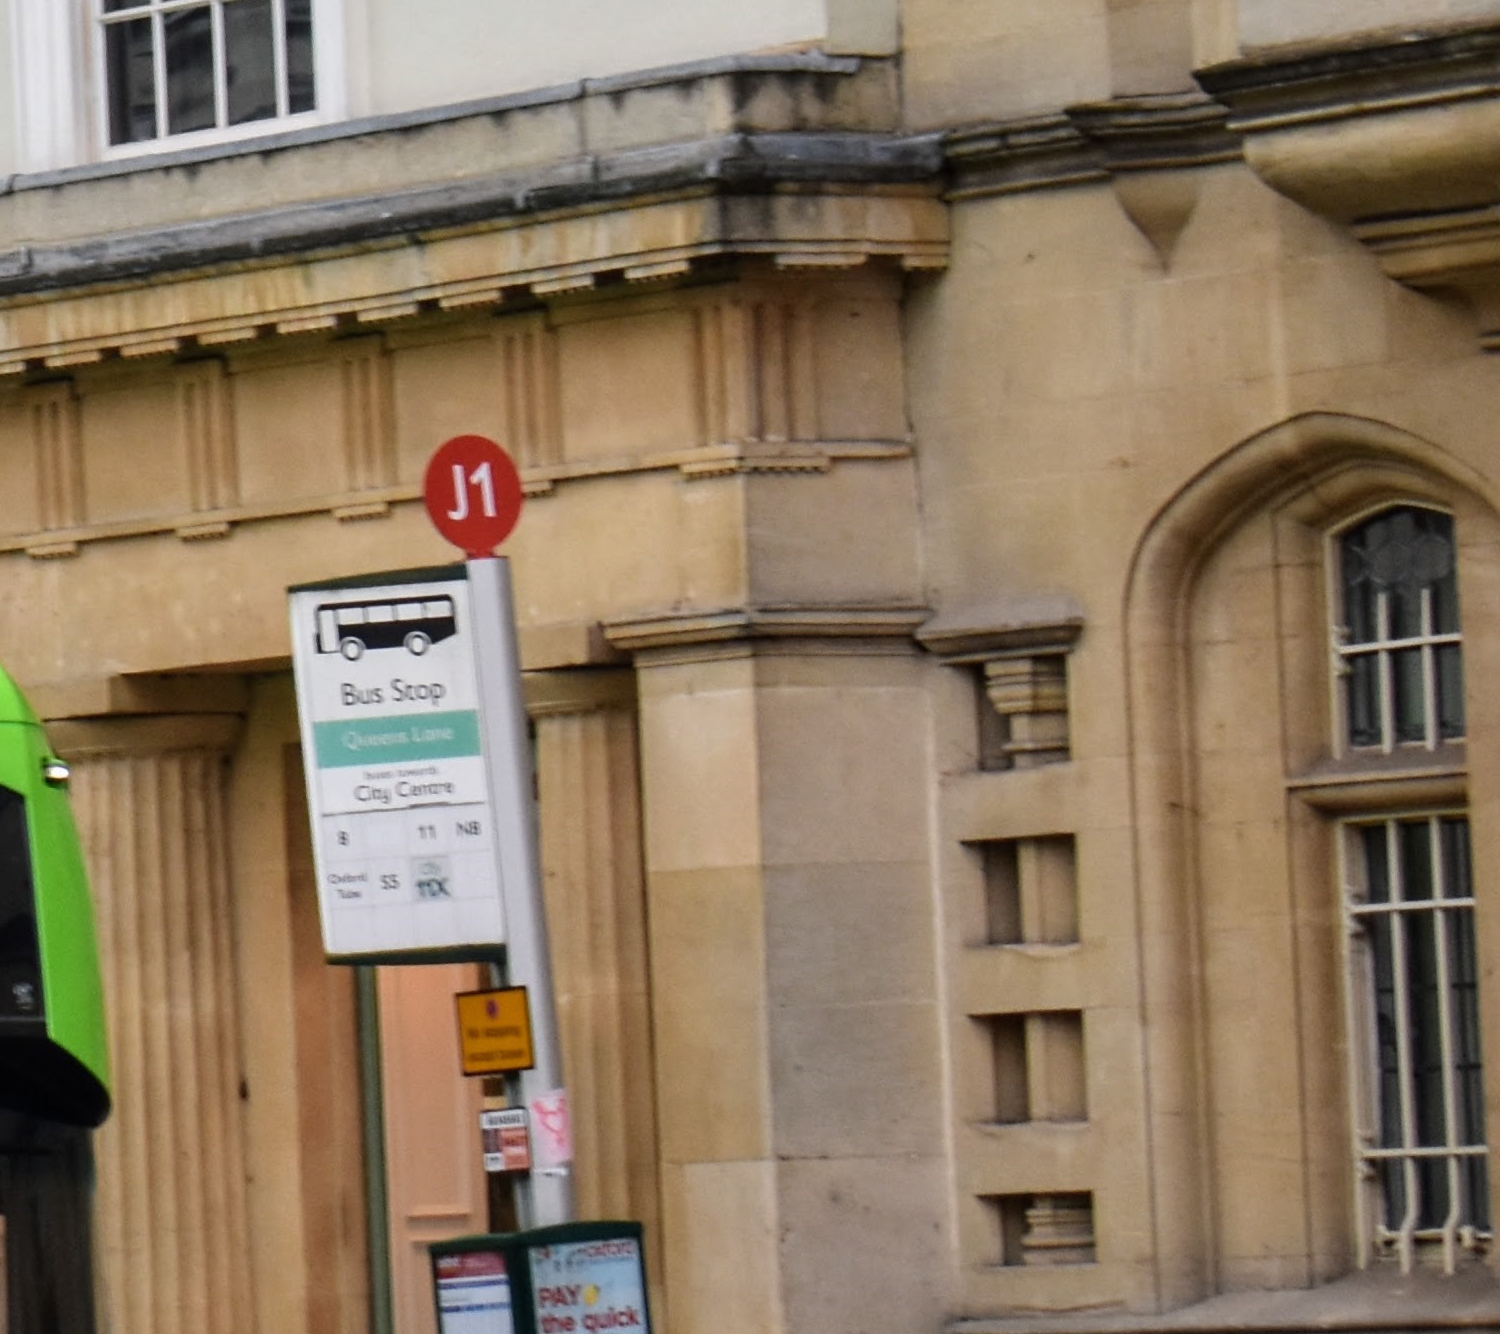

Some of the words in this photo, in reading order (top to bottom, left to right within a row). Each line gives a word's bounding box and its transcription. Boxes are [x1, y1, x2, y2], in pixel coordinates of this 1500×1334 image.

[446, 461, 498, 522] J1
[341, 683, 384, 706] Bus
[390, 679, 447, 707] Stop
[353, 784, 392, 805] City
[395, 780, 456, 799] Centre
[538, 1284, 580, 1308] PAY
[541, 1314, 576, 1334] the
[582, 1305, 641, 1333] quick
